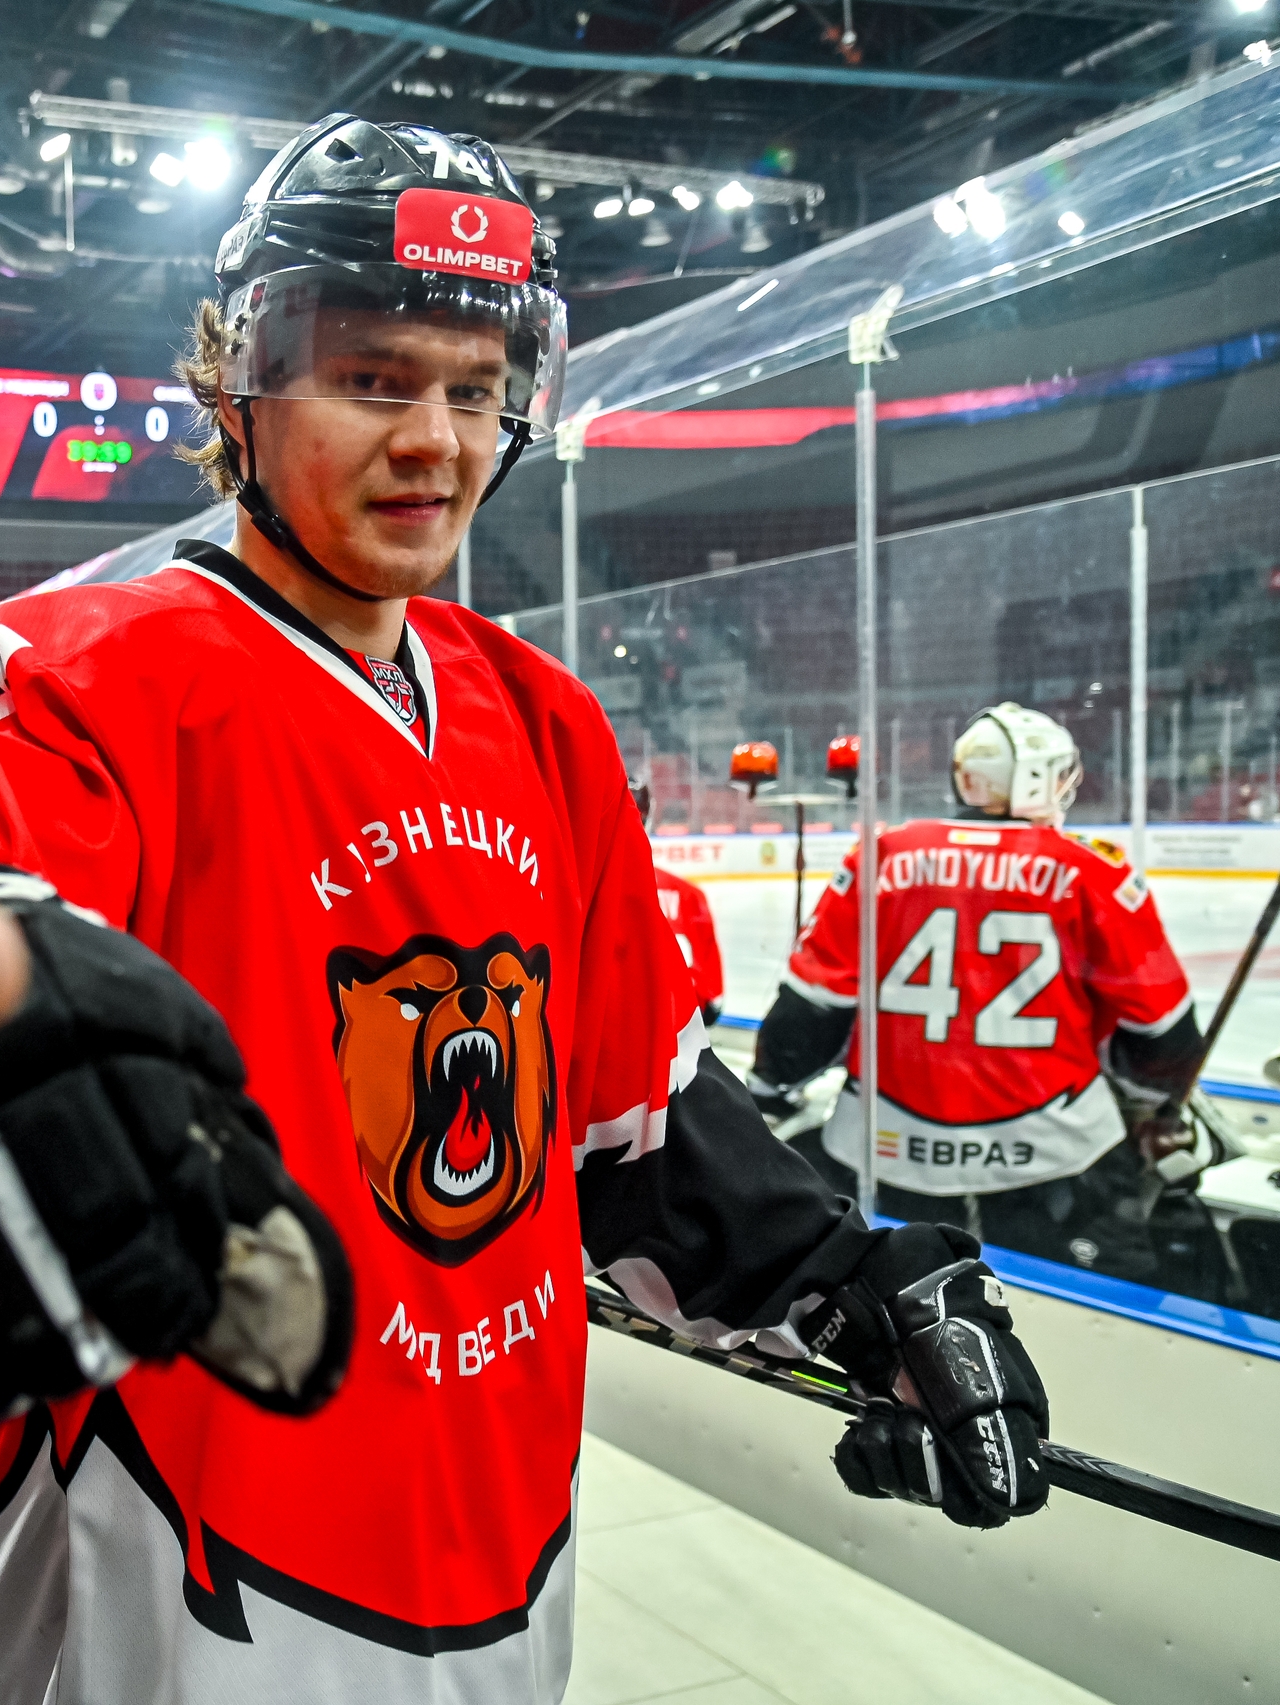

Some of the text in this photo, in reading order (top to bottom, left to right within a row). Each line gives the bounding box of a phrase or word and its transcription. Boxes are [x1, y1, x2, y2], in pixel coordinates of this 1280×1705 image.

[415, 144, 494, 187] 74
[403, 244, 523, 276] OLIMPBET
[33, 402, 57, 437] 0
[145, 406, 169, 442] 0
[373, 667, 403, 683] МХЛ
[310, 802, 543, 911] КЗНЕЦКИ
[652, 843, 724, 863] PBET
[877, 907, 1062, 1048] 42
[908, 1135, 1035, 1167] ЕВРАЗ
[379, 1269, 555, 1385] МДВЕДИ
[812, 1308, 847, 1353] CCM
[976, 1415, 1008, 1494] CCM
